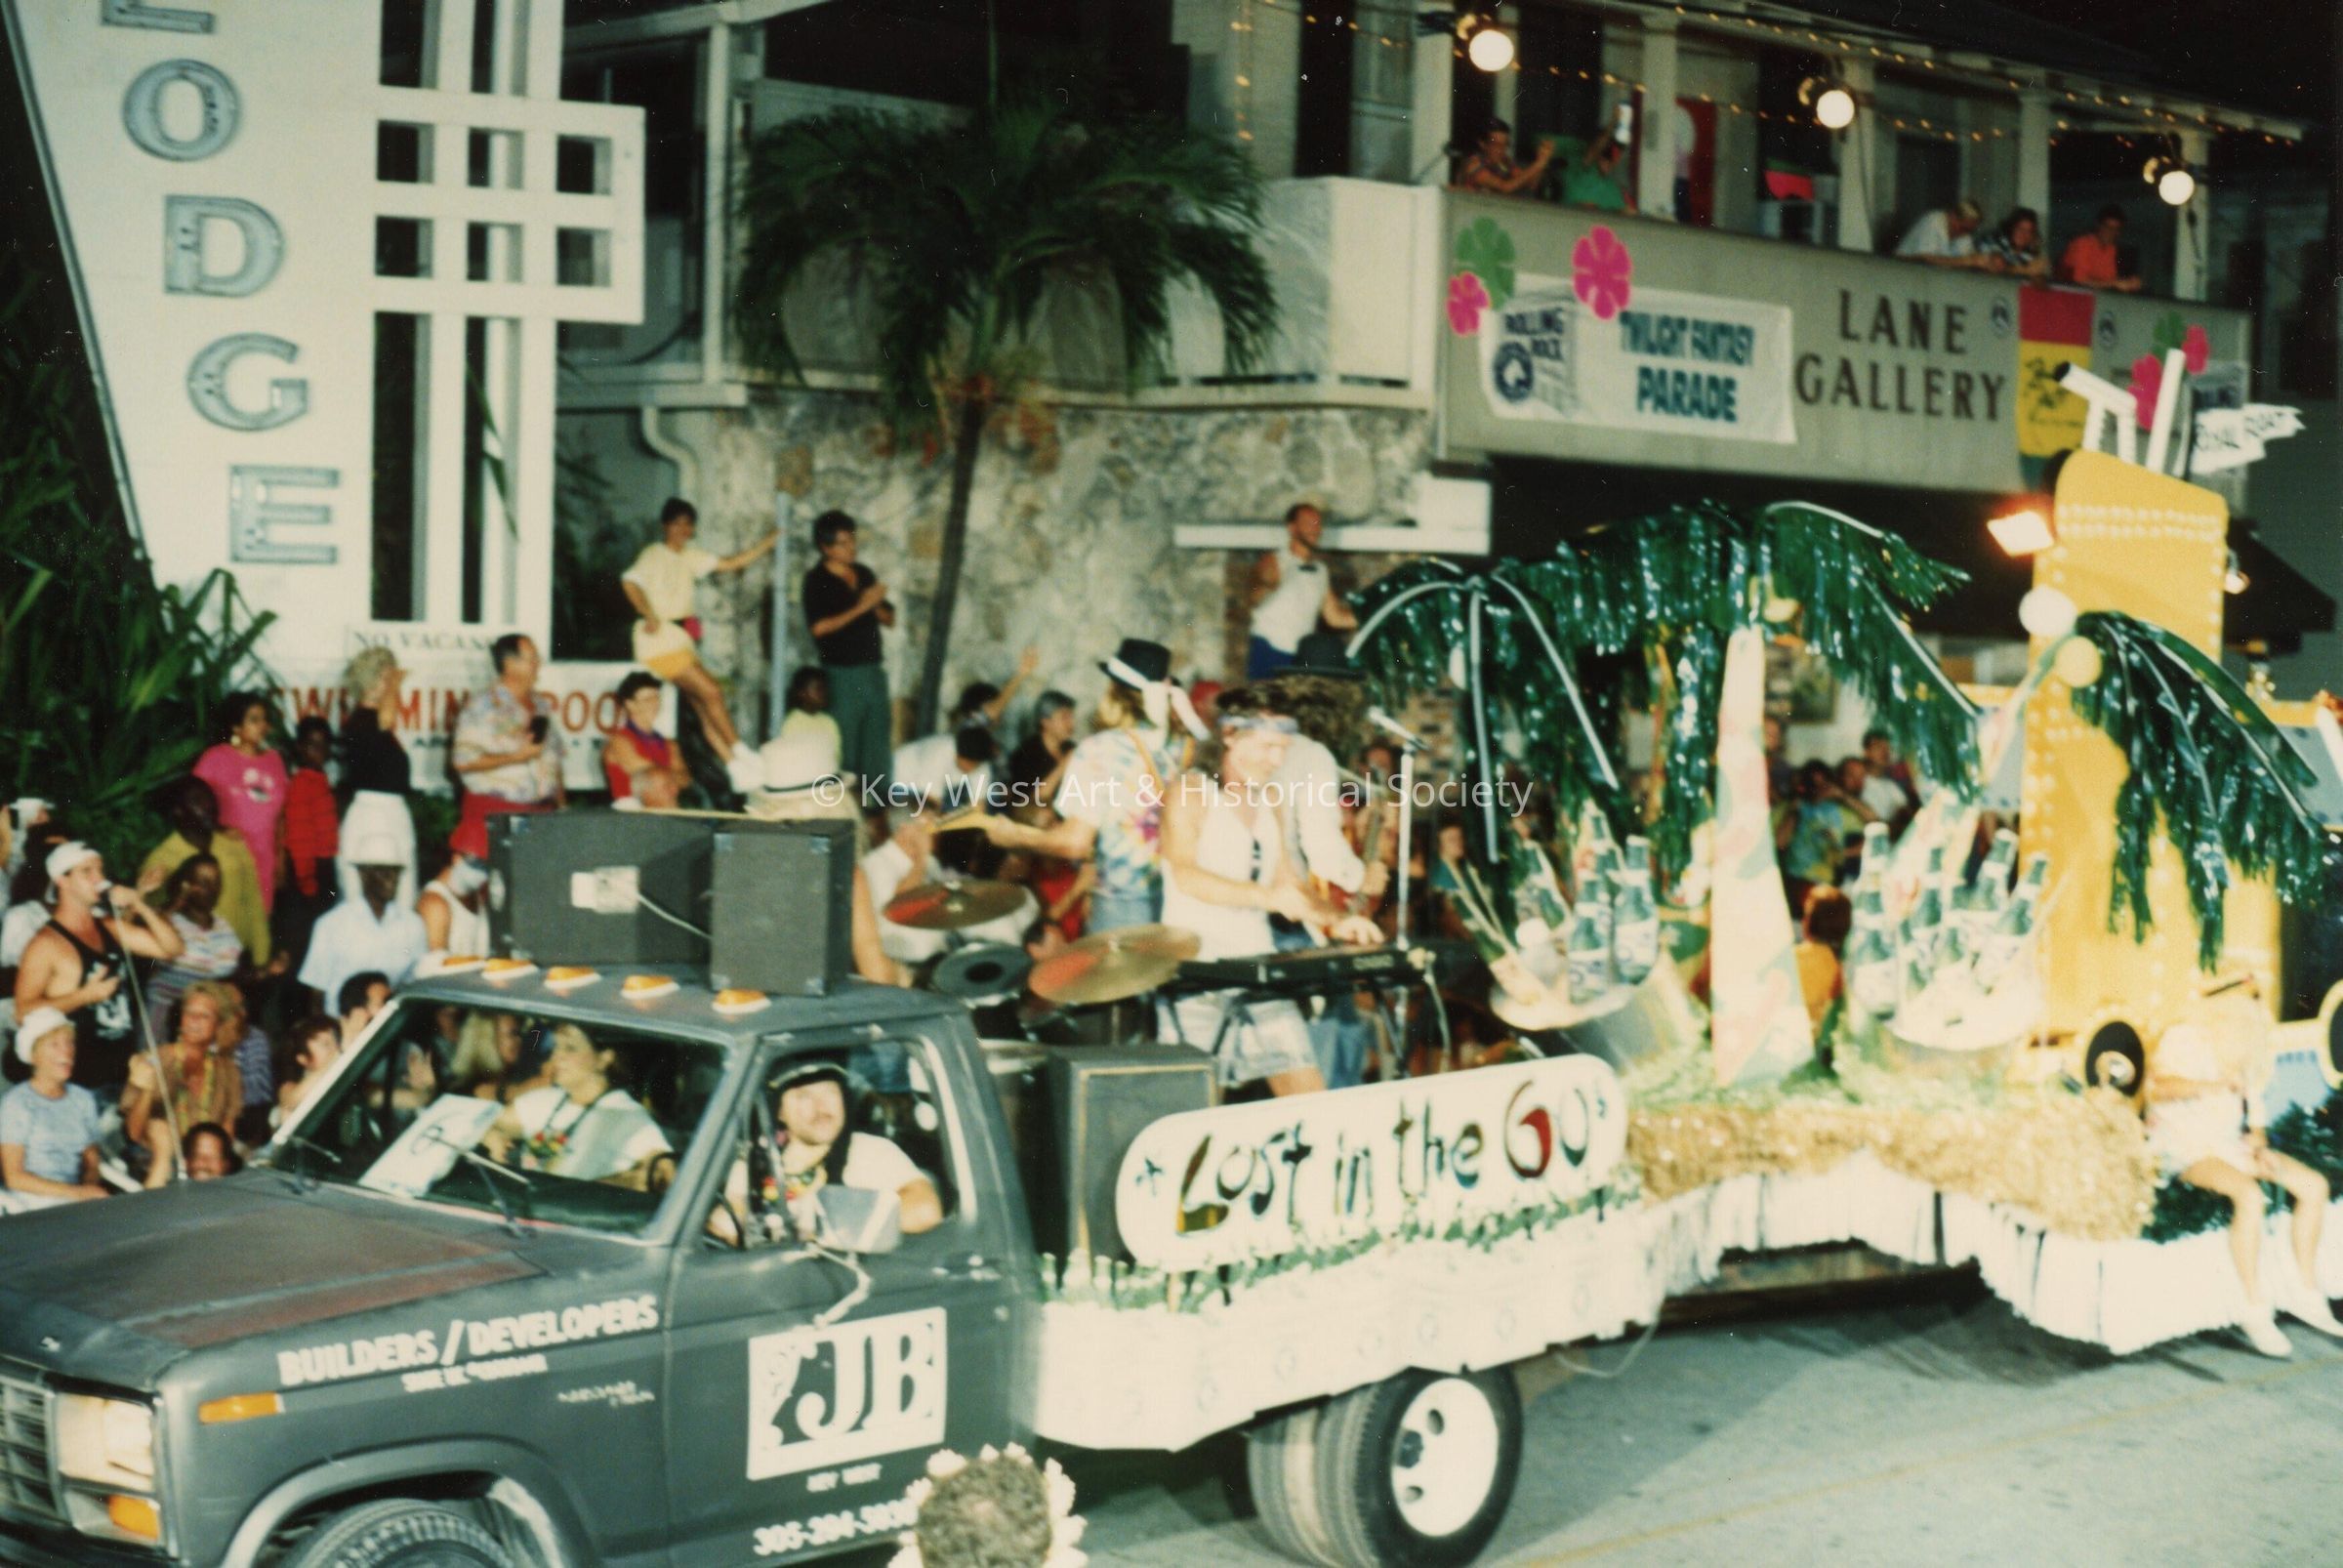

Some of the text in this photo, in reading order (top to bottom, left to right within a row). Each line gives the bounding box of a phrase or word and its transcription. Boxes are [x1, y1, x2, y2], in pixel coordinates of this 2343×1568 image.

[1838, 289, 1968, 354] LANE
[1637, 366, 1737, 422] PARADE
[1795, 352, 2007, 421] GALLERY
[533, 690, 621, 733] POO
[1176, 1120, 1312, 1236] Lost
[1335, 1131, 1374, 1217] in
[1393, 1095, 1482, 1203] the
